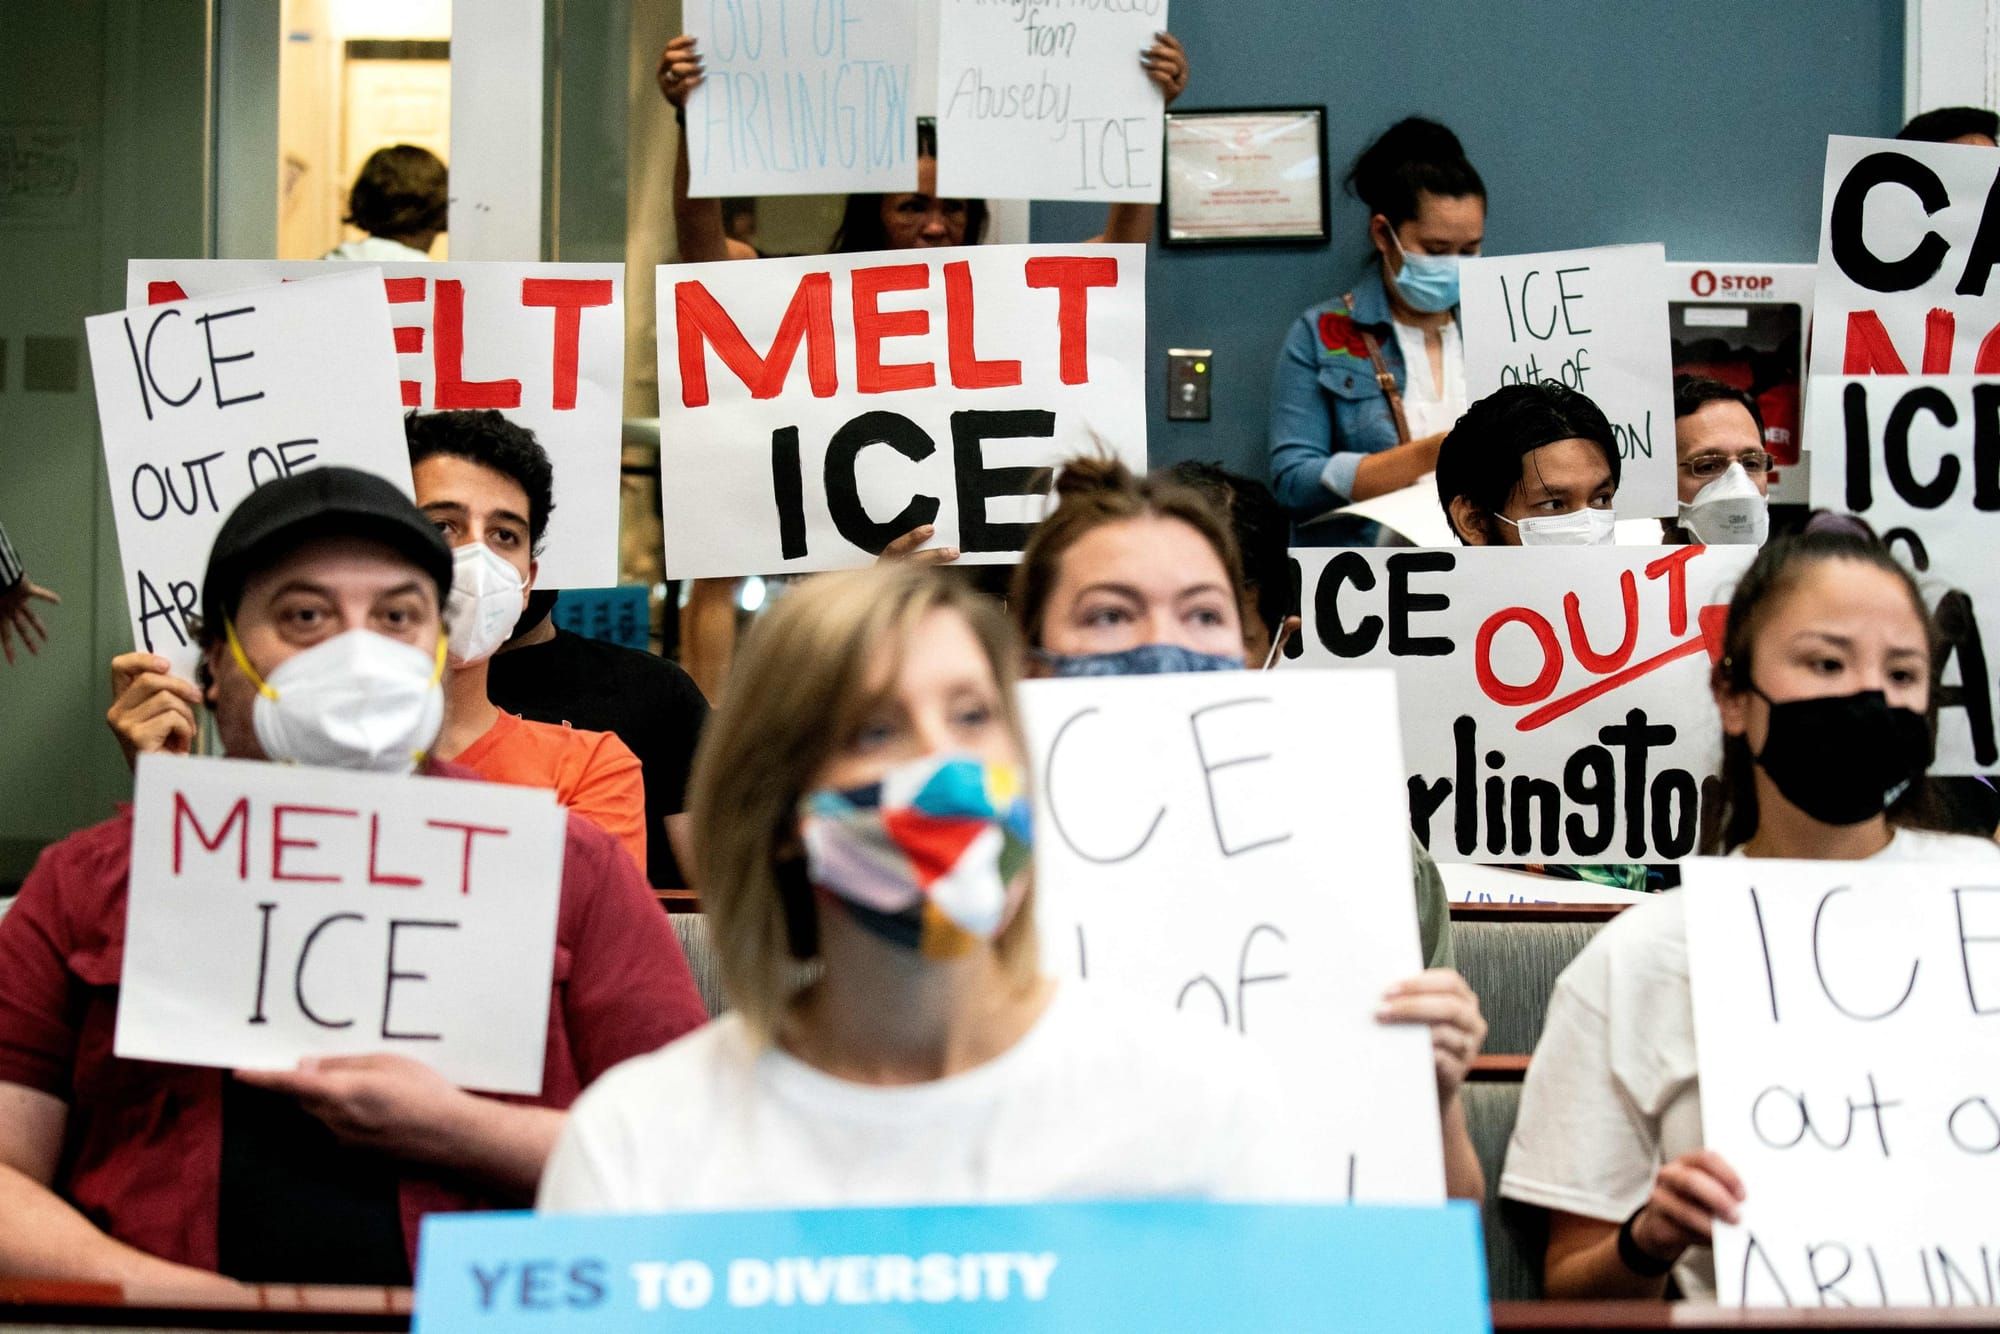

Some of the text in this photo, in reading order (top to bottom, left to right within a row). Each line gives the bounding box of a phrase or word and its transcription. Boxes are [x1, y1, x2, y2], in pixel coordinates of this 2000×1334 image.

[1024, 8, 1076, 57] from
[702, 60, 909, 176] ARLINGTON
[1071, 117, 1152, 190] ICE
[1500, 266, 1592, 343] ICE
[1721, 275, 1773, 291] STOP
[124, 306, 265, 420] ICE
[675, 256, 1119, 409] MELT
[1610, 410, 1652, 460] ON
[132, 451, 225, 521] OUT
[771, 410, 1056, 561] ICE
[1475, 544, 1707, 706] OUT
[171, 790, 509, 895] MELT
[248, 902, 460, 1042] ICE
[468, 1252, 1057, 1310] YES TO DIVERSITY
